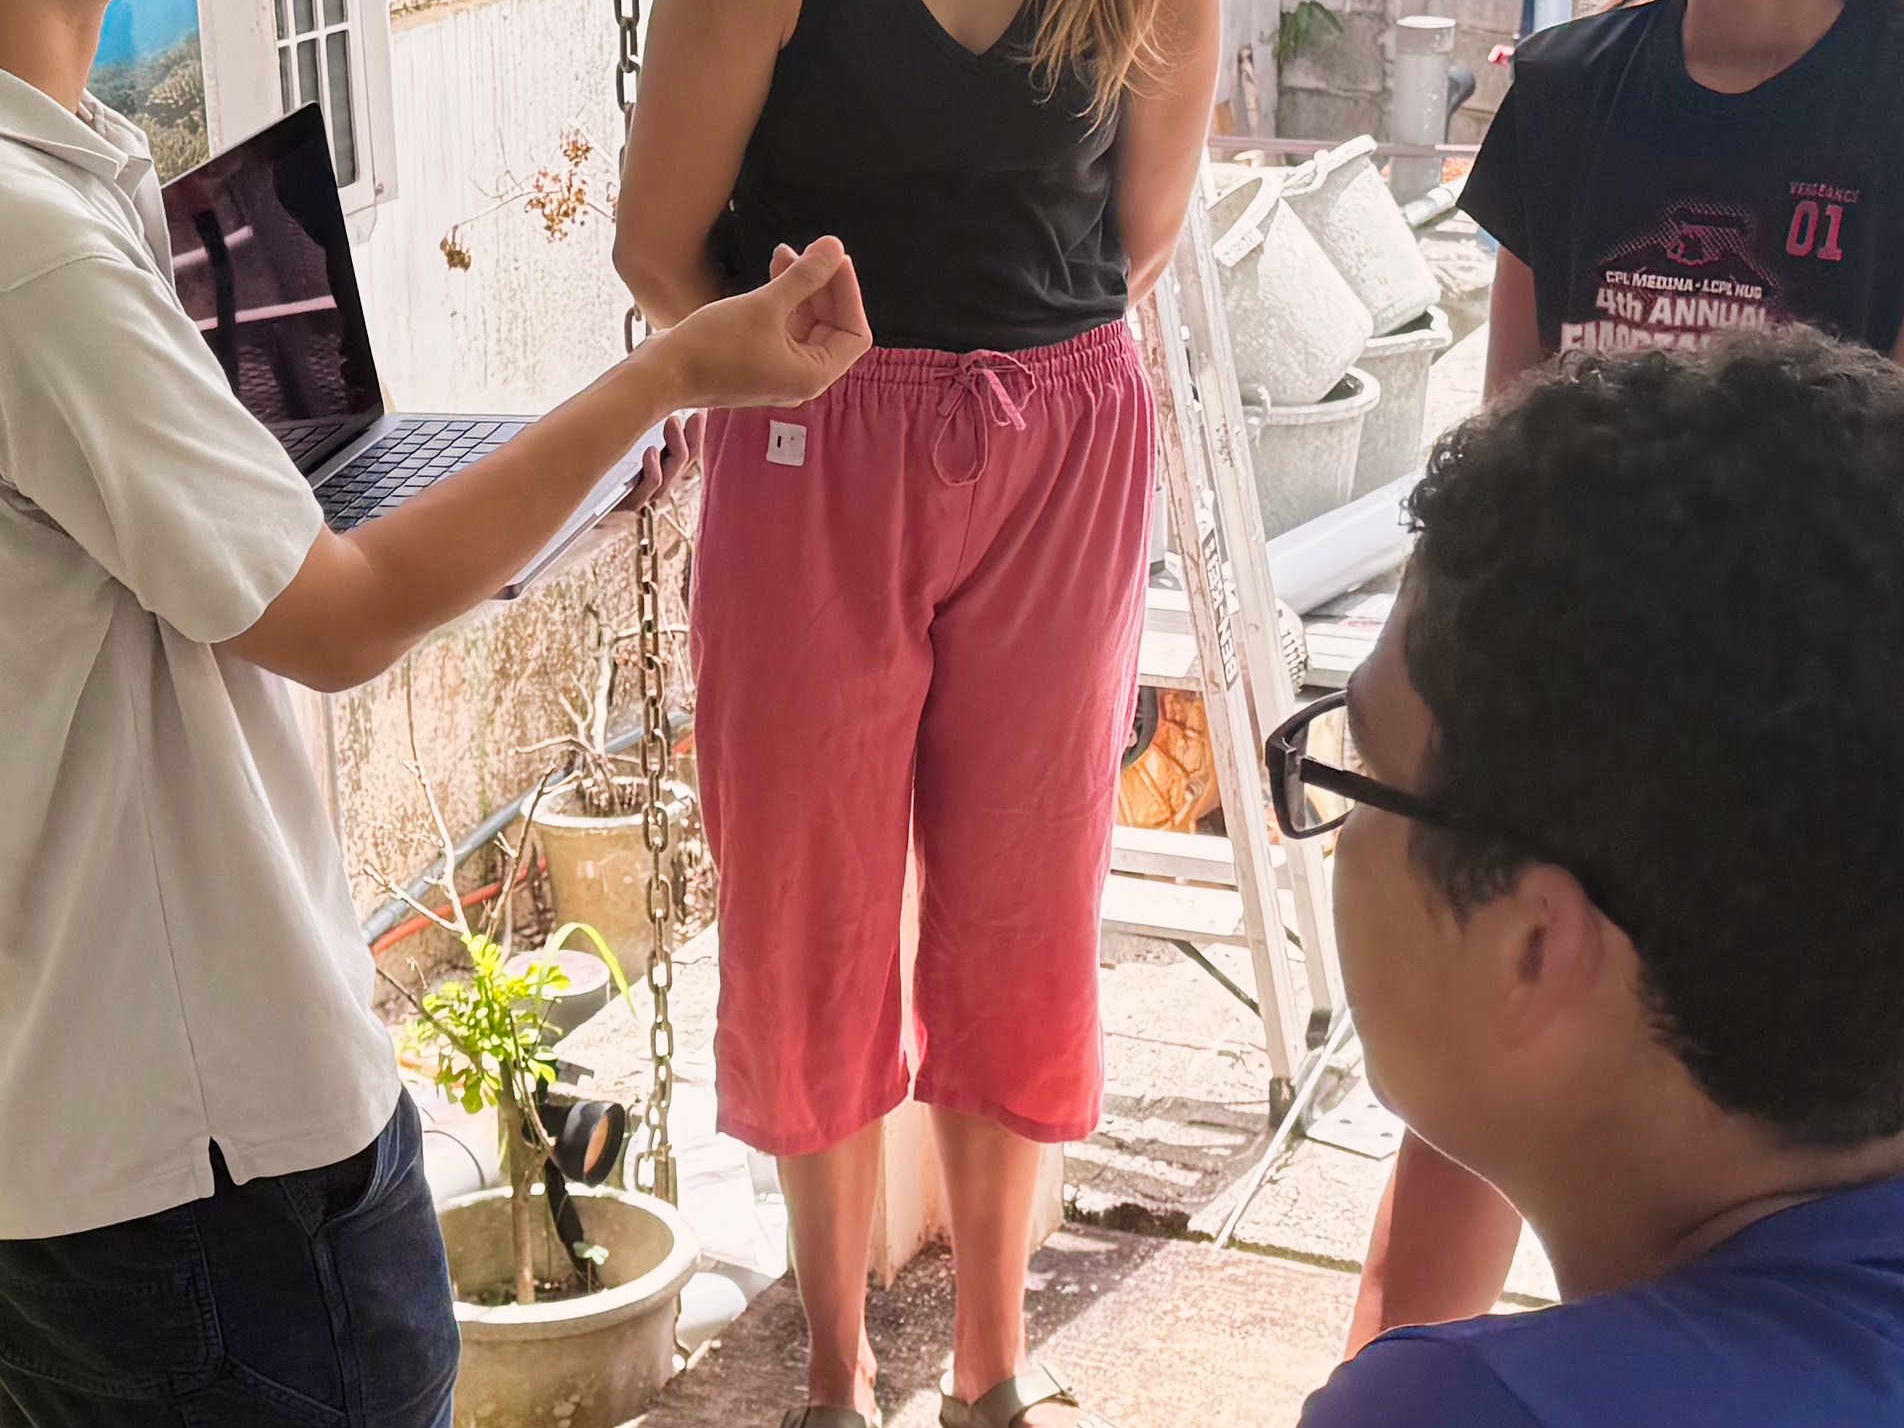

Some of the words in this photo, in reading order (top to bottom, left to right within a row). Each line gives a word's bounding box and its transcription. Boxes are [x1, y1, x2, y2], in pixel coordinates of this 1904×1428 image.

[1785, 199, 1844, 261] 01
[1631, 272, 1694, 292] MEDINA
[1595, 287, 1643, 322] 4th
